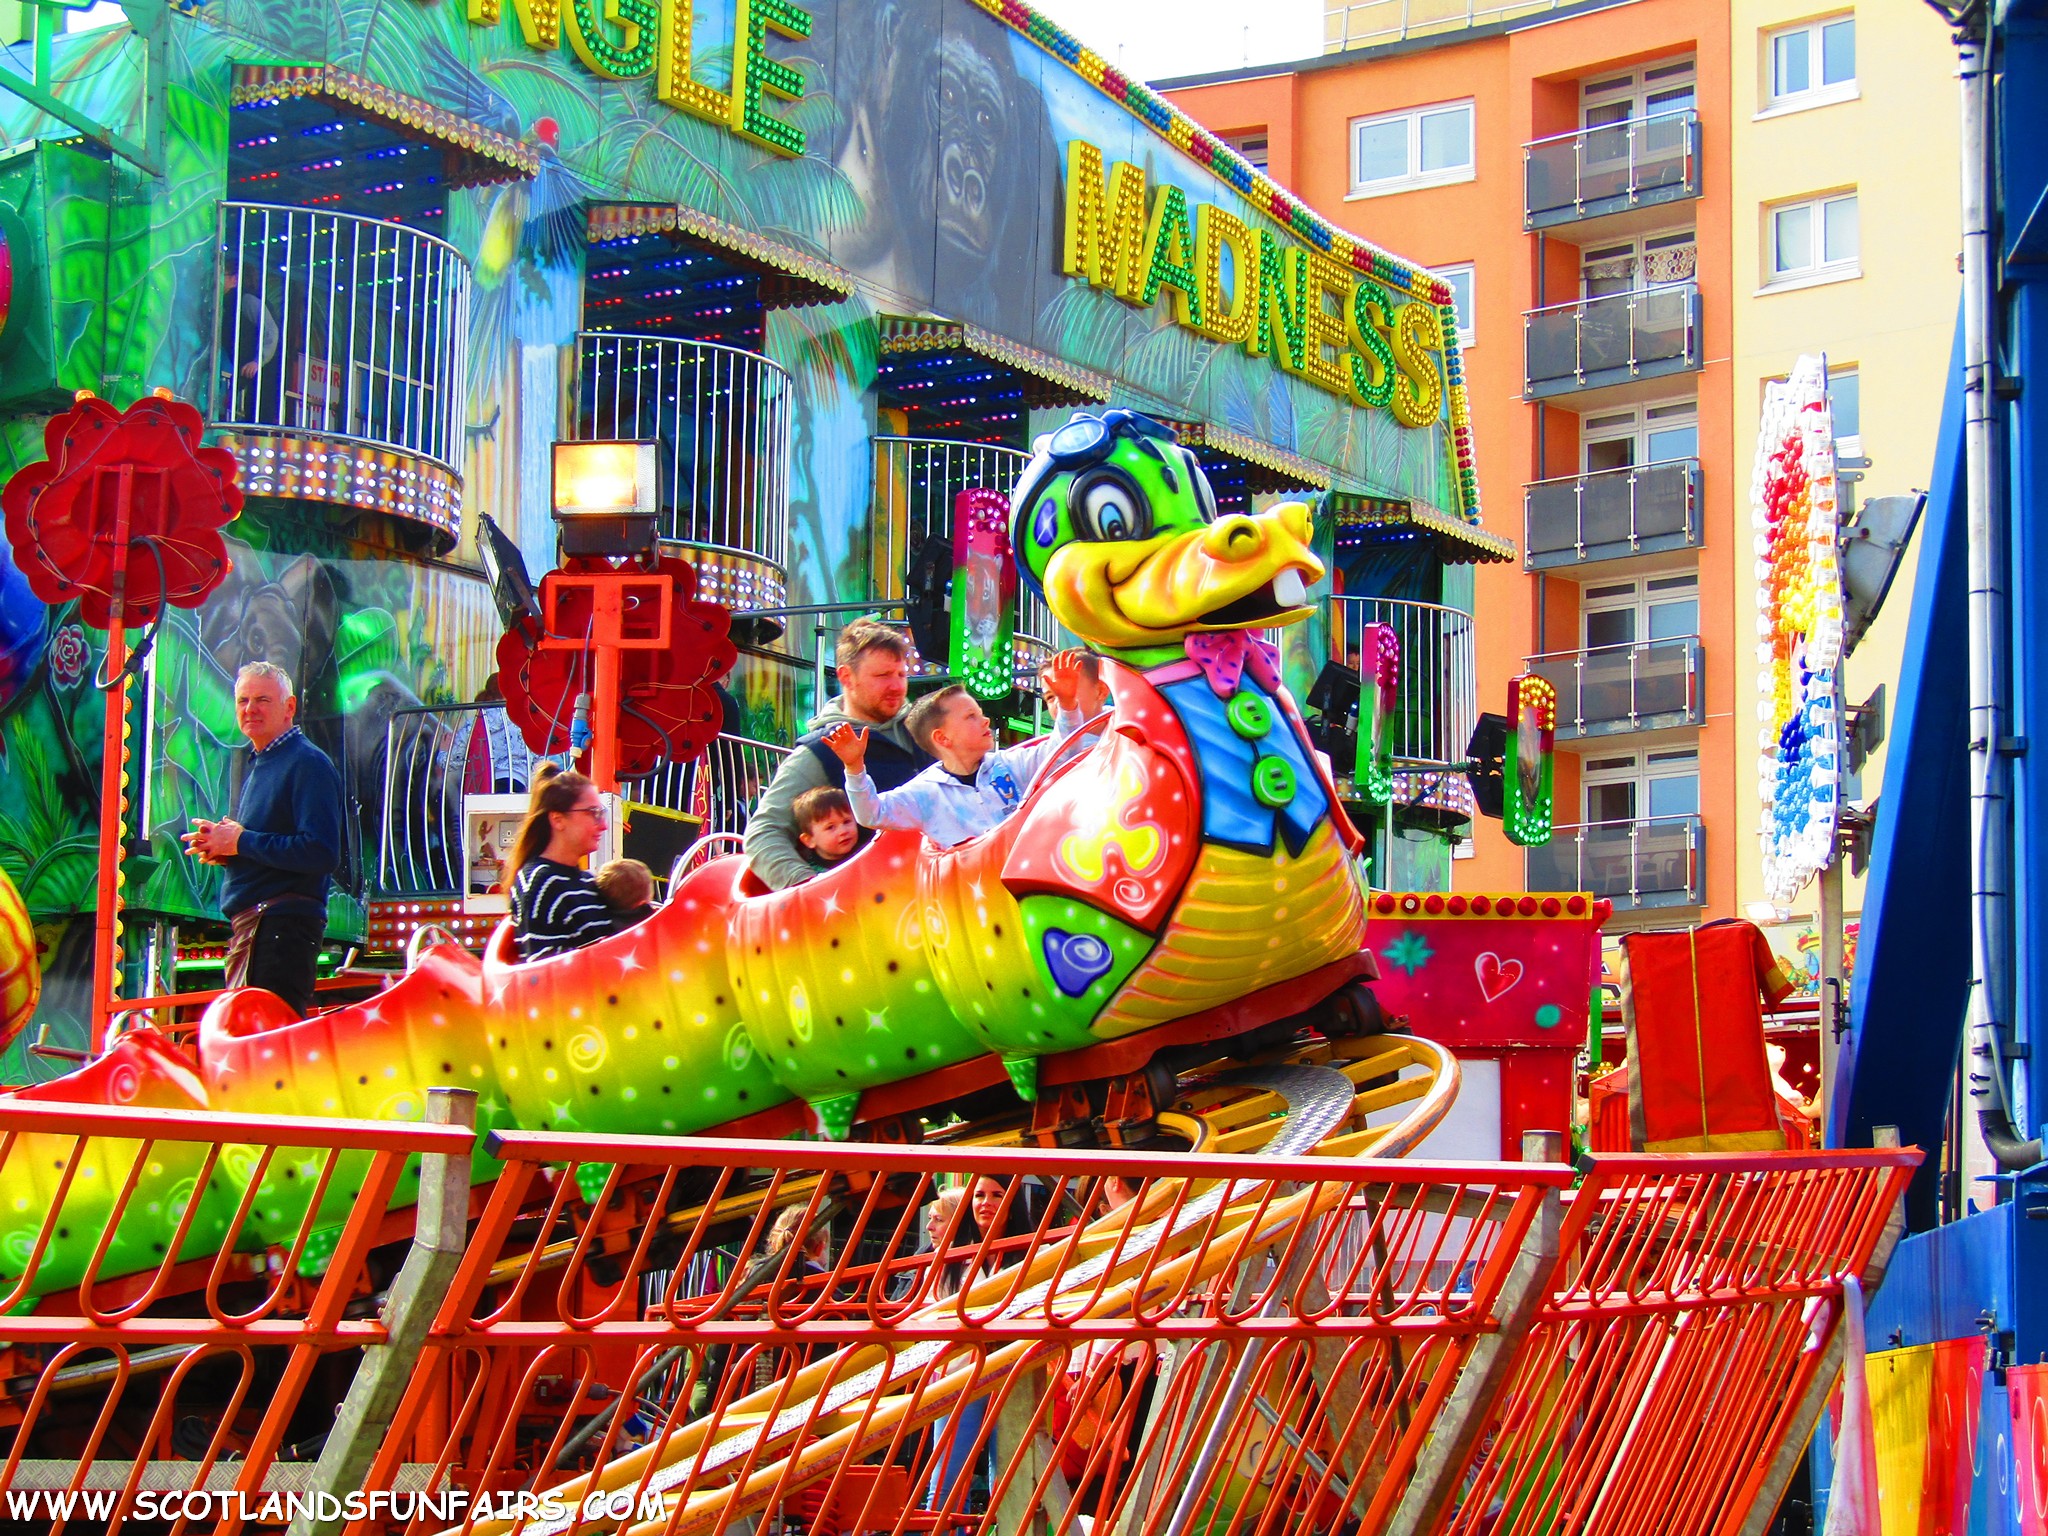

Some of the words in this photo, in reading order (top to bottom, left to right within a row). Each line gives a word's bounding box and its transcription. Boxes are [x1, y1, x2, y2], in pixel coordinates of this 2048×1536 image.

[467, 0, 813, 158] GLE
[1063, 139, 1442, 428] MADNESS
[311, 364, 340, 388] STAR
